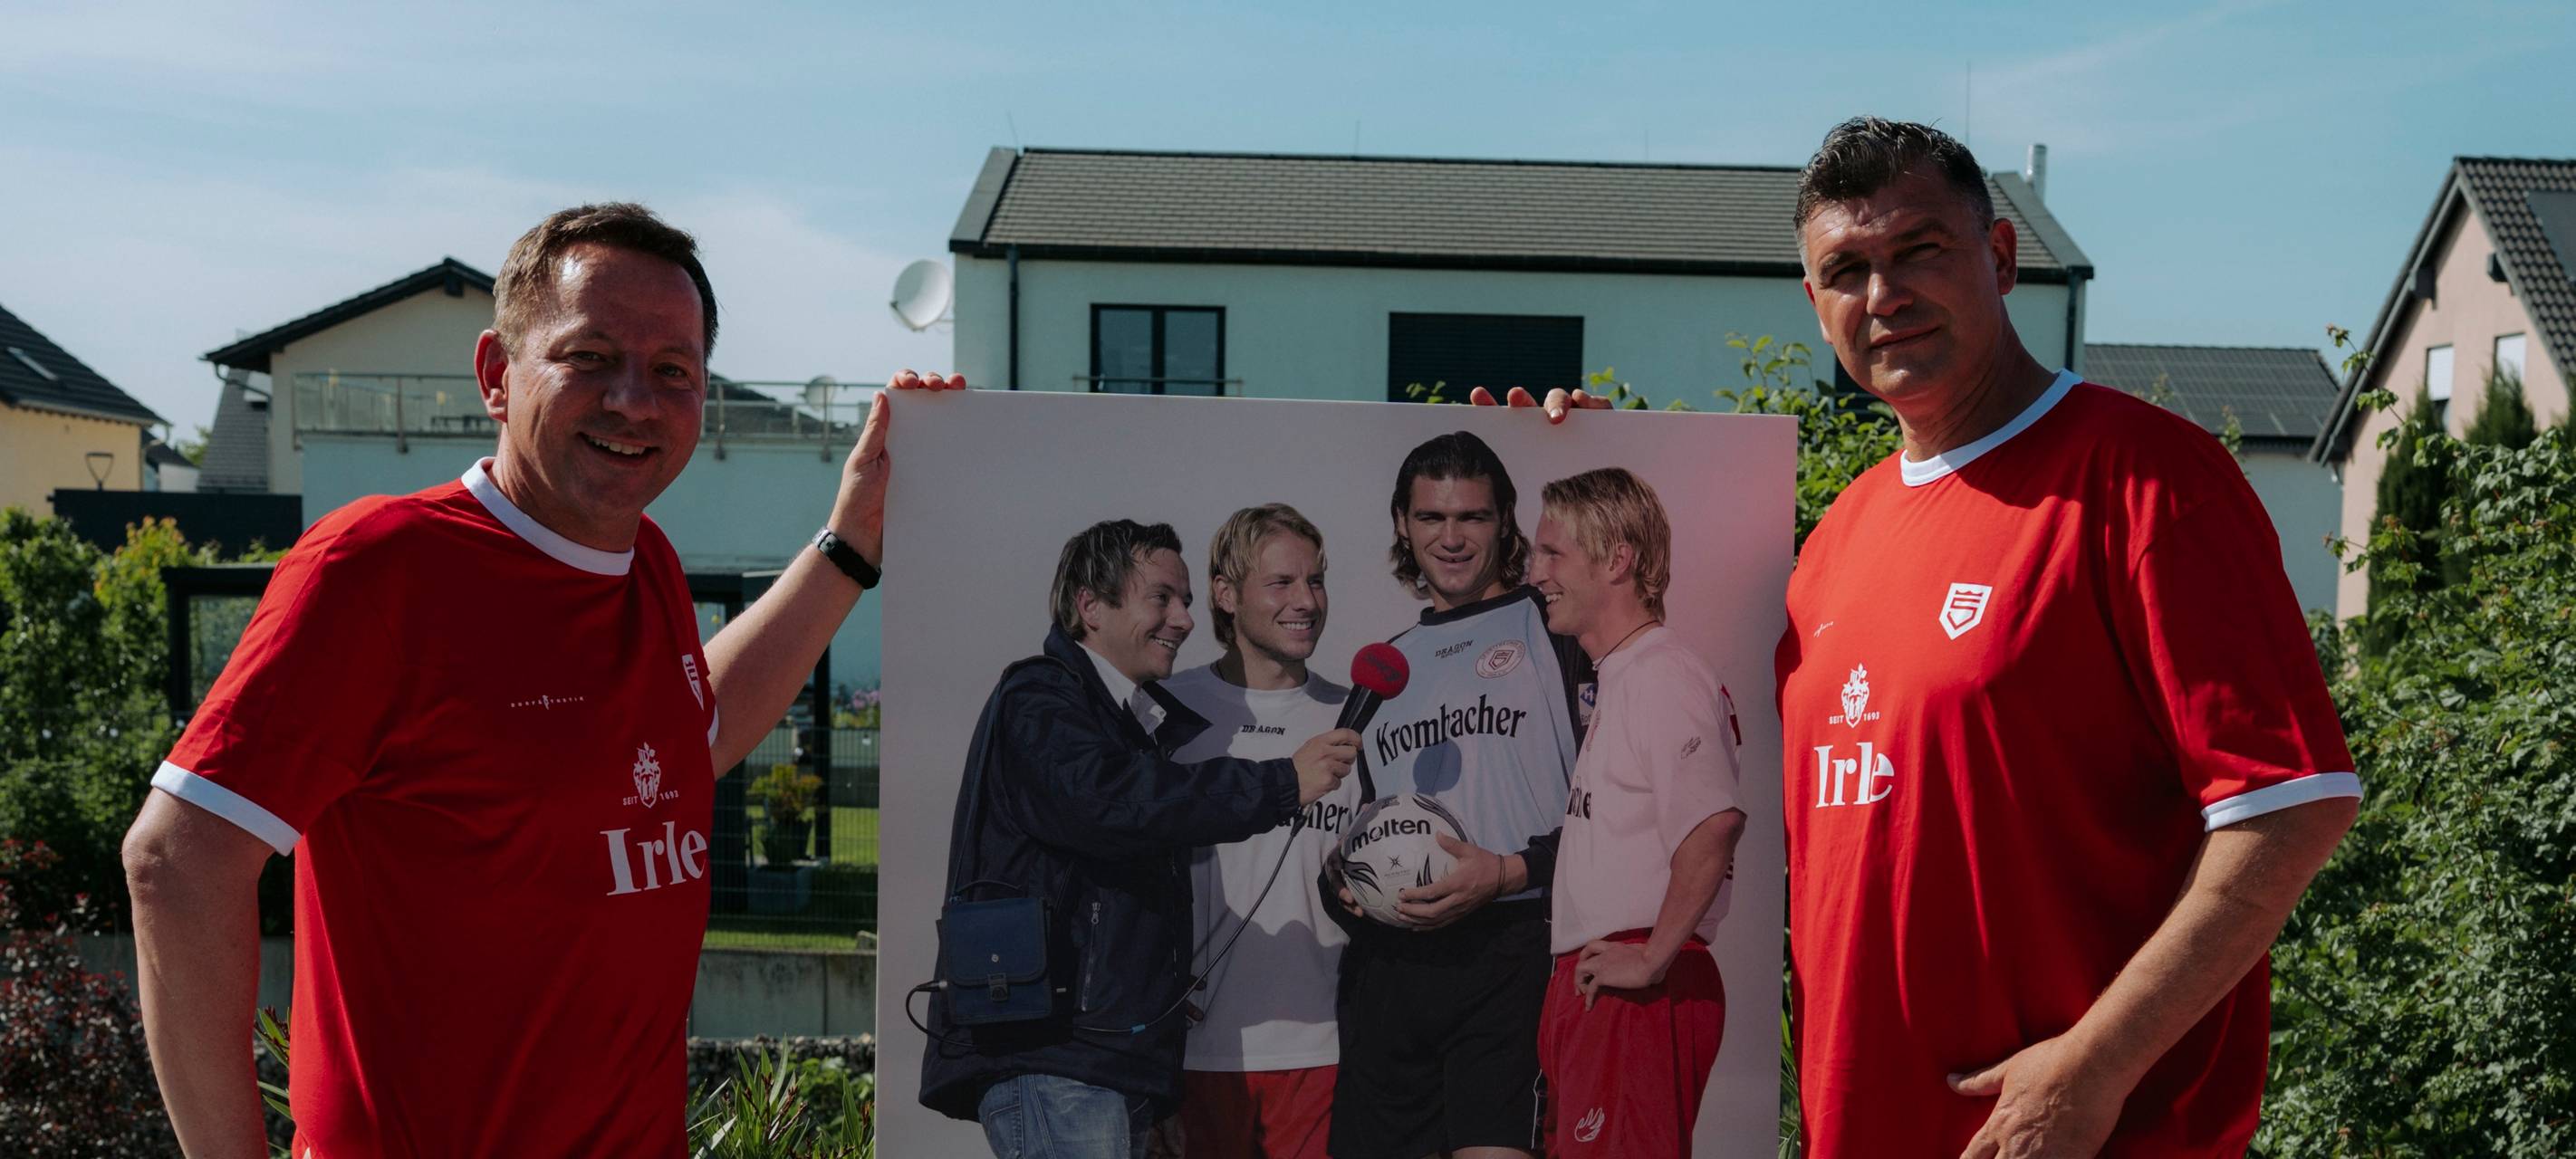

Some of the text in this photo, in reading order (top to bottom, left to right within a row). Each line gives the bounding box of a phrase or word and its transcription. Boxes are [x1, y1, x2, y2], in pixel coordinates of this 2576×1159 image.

[1435, 639, 1474, 657] DRAGON
[1242, 724, 1285, 735] DRAGON
[1376, 694, 1527, 766] Krombacher
[1829, 712, 1880, 724] SEIT 1693
[1813, 742, 1894, 808] Irle
[622, 790, 679, 806] SEIT 1693
[1351, 819, 1432, 853] molten
[600, 820, 707, 896] Irle
